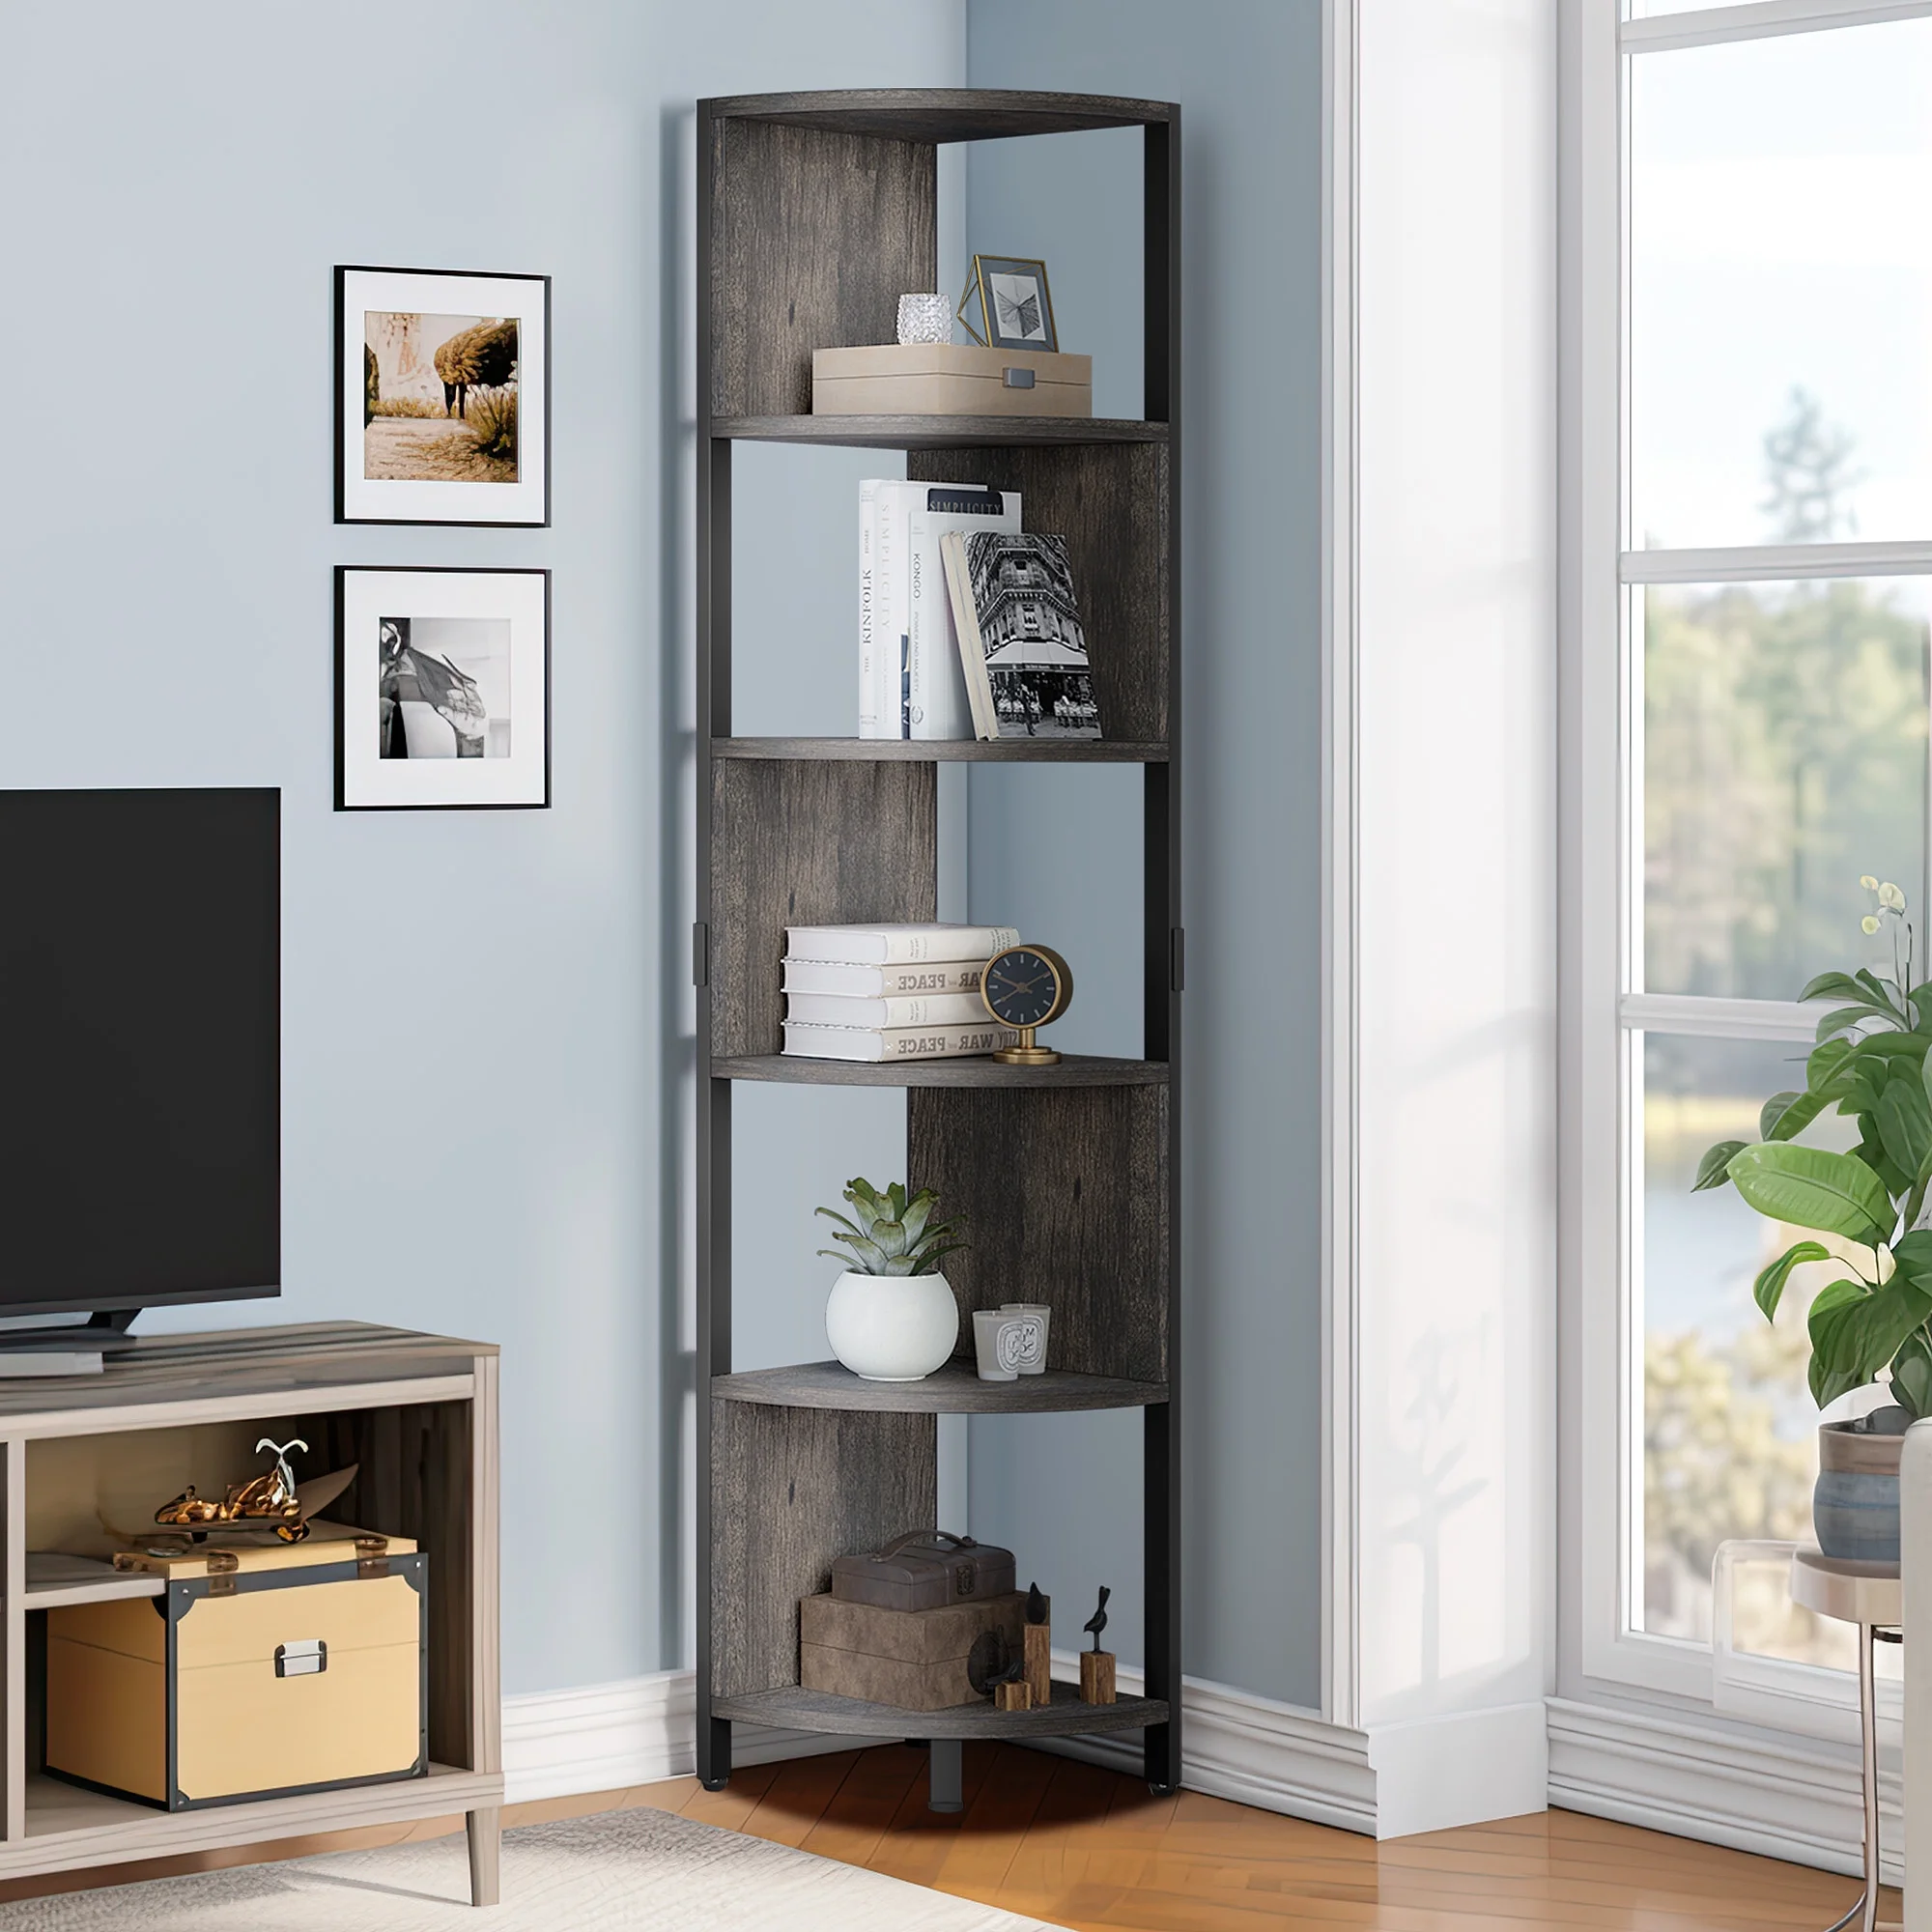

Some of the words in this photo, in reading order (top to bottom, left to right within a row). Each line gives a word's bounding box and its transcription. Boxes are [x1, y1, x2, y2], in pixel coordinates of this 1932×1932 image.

[929, 500, 1001, 515] SIMPLICITY
[881, 504, 891, 629] SIMPLICITY
[863, 569, 872, 644] KINFOLK
